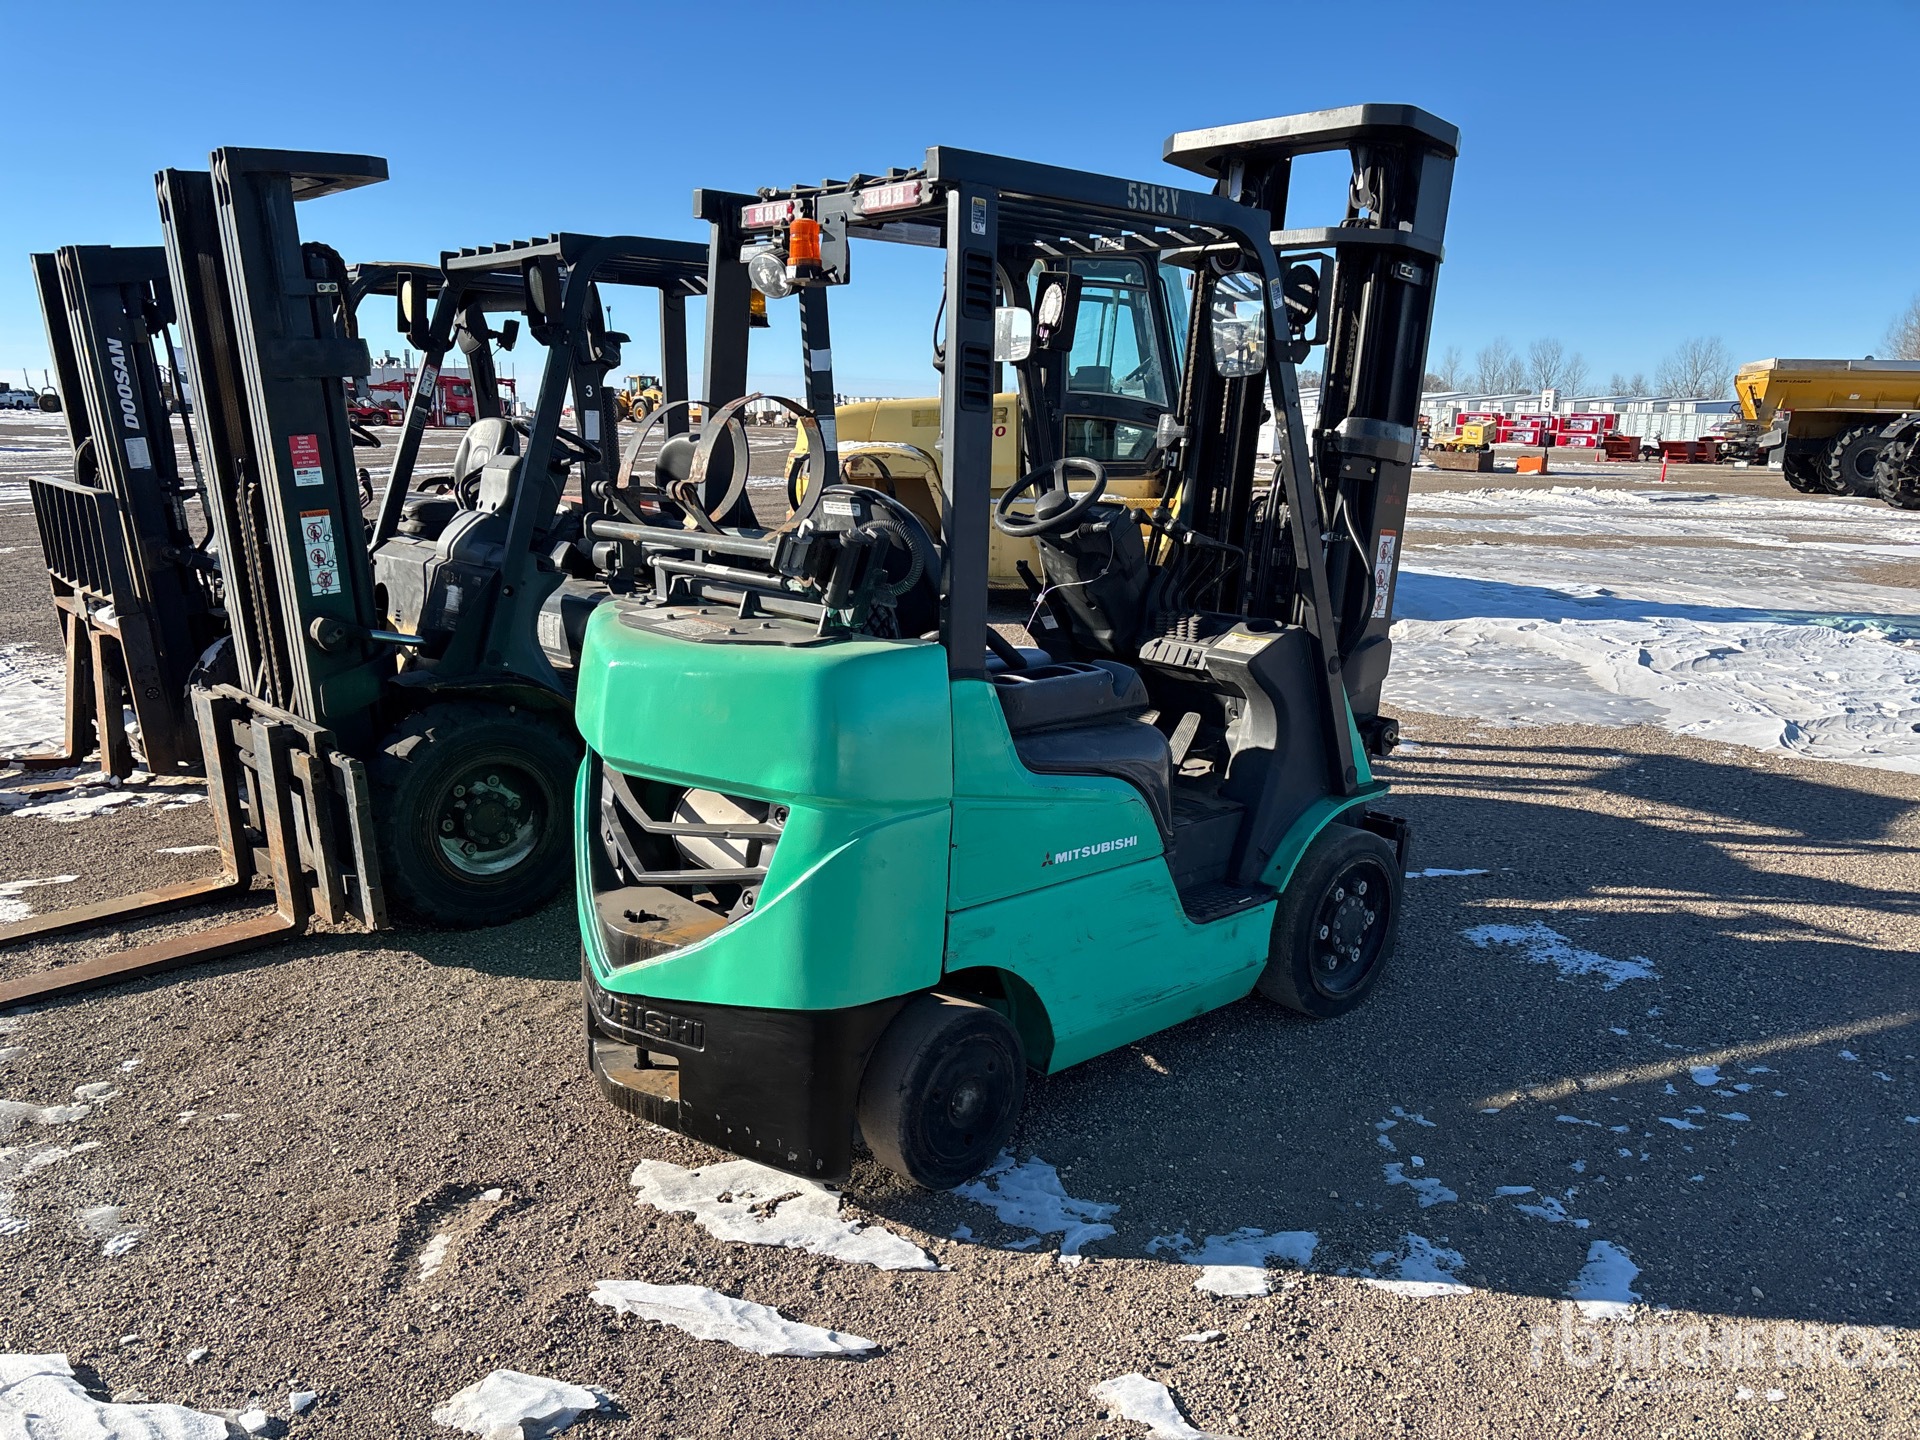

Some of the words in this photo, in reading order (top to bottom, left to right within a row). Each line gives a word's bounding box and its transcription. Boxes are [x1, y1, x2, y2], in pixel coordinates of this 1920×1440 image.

[1127, 182, 1180, 215] 5513V
[106, 337, 140, 430] DOOSAN
[585, 385, 593, 397] 3
[1544, 397, 1550, 408] 5
[1055, 835, 1138, 864] MITSUBISHI
